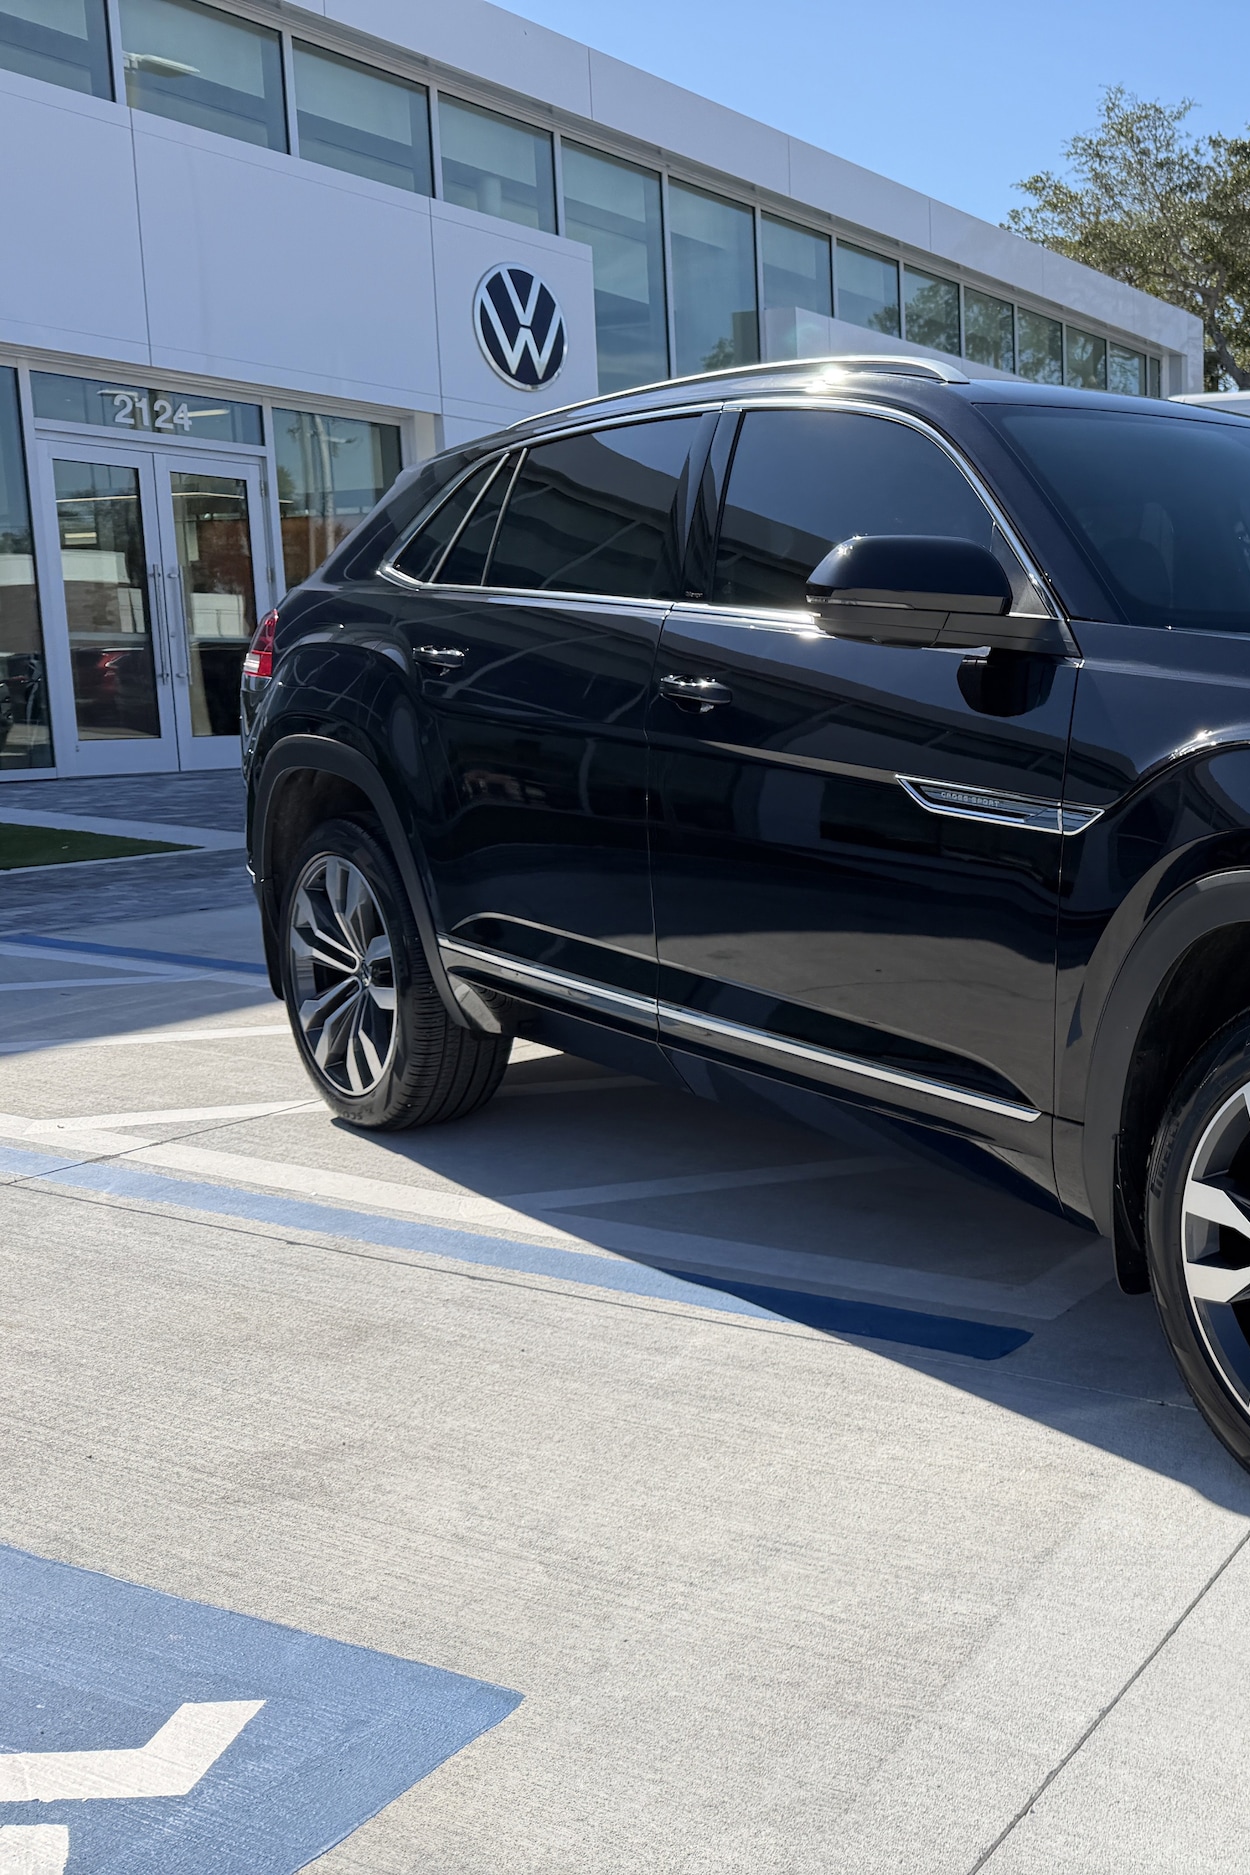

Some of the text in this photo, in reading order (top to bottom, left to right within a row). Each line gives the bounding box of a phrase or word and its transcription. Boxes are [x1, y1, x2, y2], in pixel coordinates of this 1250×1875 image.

[474, 262, 568, 391] VW
[113, 394, 193, 431] 2124
[941, 792, 1000, 807] CROSS SPORT
